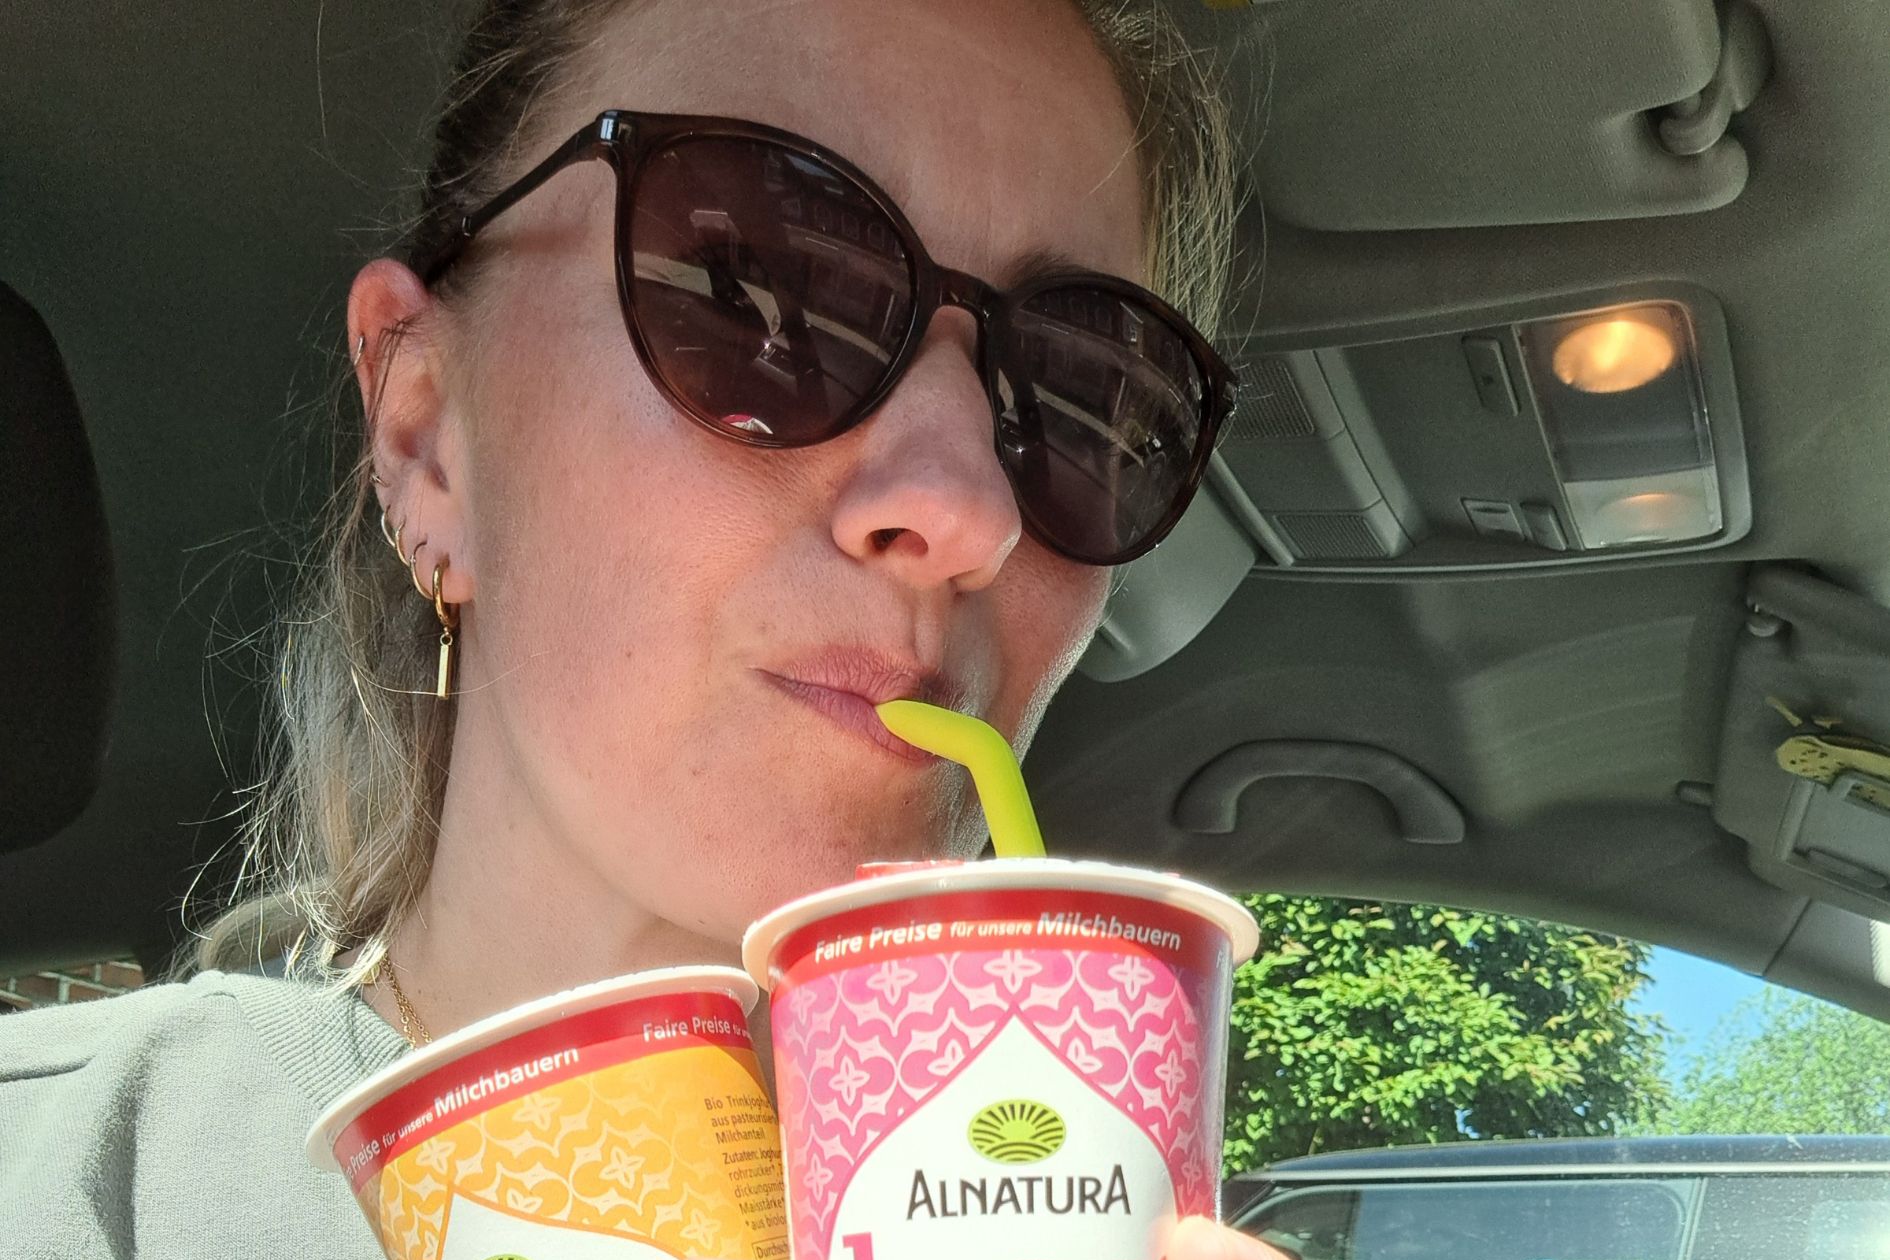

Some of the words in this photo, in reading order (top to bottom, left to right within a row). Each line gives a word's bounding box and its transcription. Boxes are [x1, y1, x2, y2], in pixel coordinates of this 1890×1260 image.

[814, 935, 863, 964] Faire
[869, 919, 942, 951] Preise
[950, 921, 975, 938] für
[977, 921, 1032, 938] unsere
[1036, 911, 1182, 951] Milchbauern
[643, 1019, 688, 1042] Faire
[692, 1015, 731, 1035] Preise
[350, 1139, 381, 1174] Preise
[382, 1132, 396, 1149] für
[398, 1111, 434, 1139] unsere
[433, 1047, 580, 1119] Milchbauern
[704, 1097, 723, 1111] Bio
[711, 1116, 730, 1127] aus
[715, 1127, 766, 1145] Milchanteil
[906, 1164, 1132, 1220] ALNATURA
